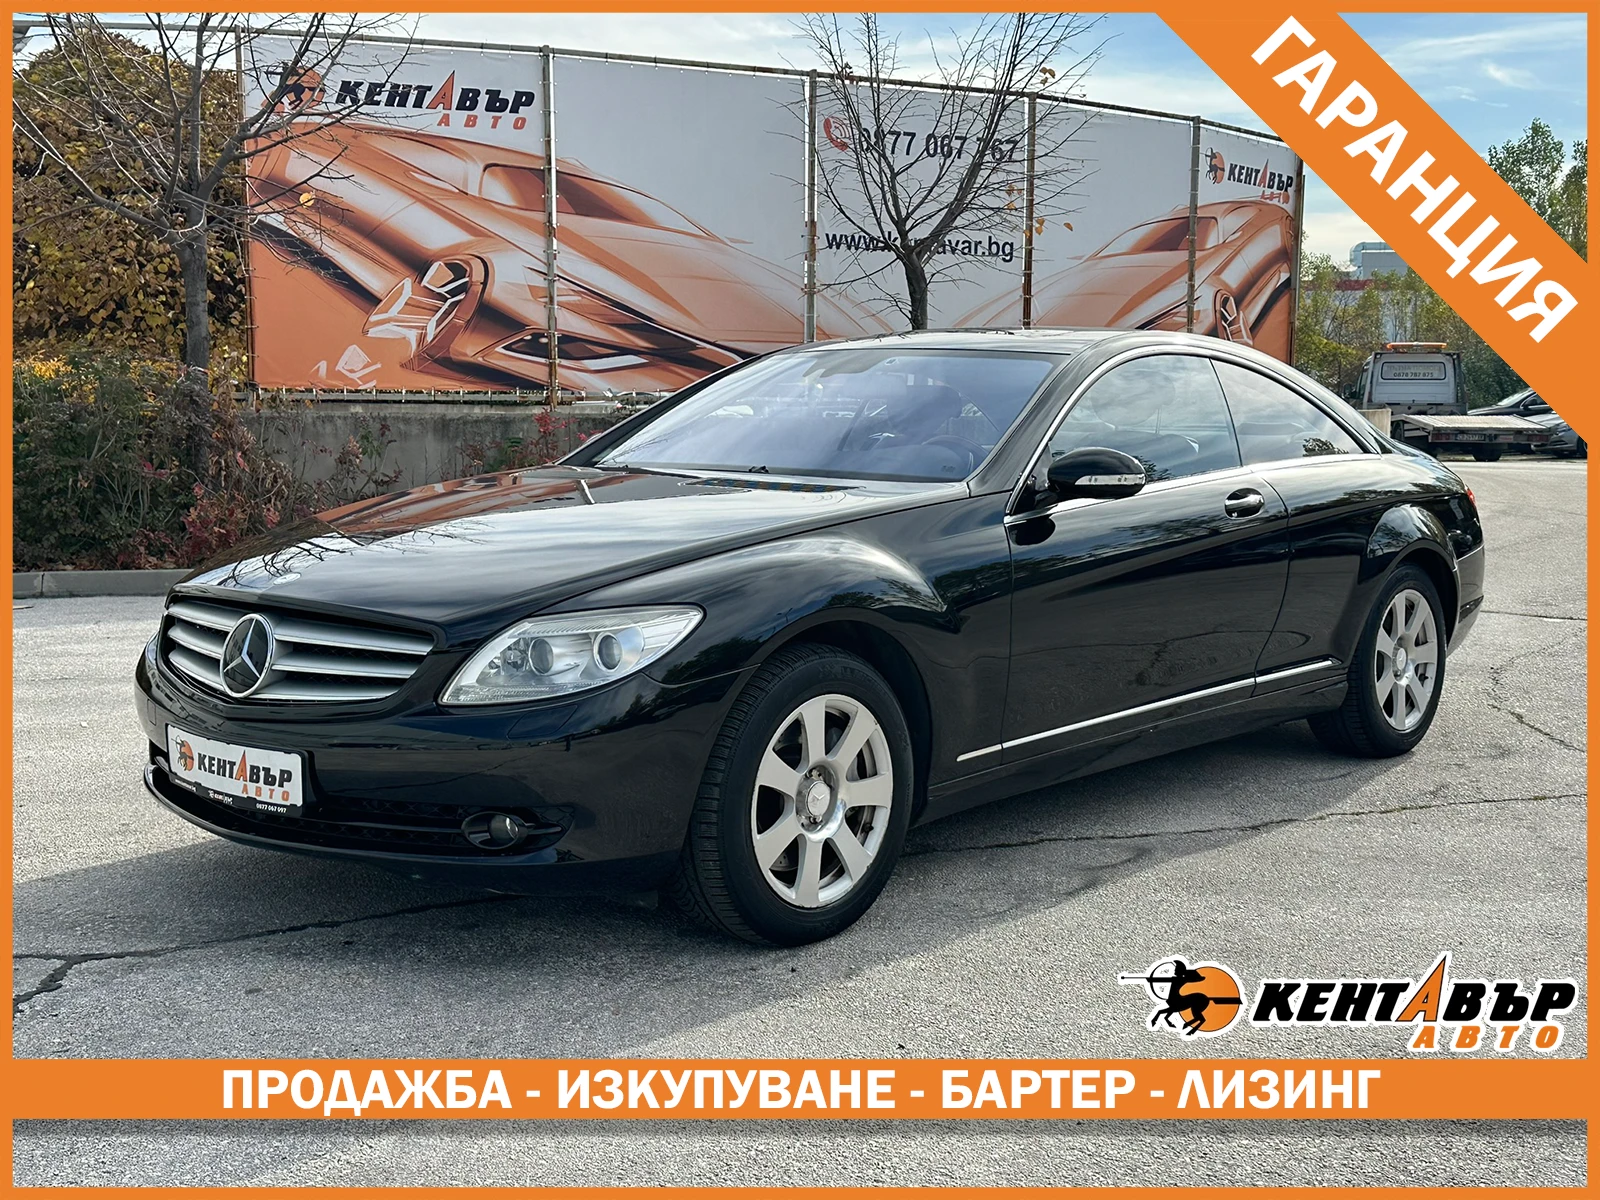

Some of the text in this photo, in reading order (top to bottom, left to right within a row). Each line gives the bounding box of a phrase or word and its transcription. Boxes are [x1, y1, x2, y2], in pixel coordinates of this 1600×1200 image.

[335, 70, 535, 114] КЕНТАВЪР
[437, 113, 527, 130] АВТО
[925, 132, 967, 159] 067
[1227, 158, 1294, 192] КЕНТАВЪР
[825, 231, 1014, 263] www.kavar.bg
[197, 750, 293, 788] КЕНТАВЪР
[241, 783, 290, 802] АВТО
